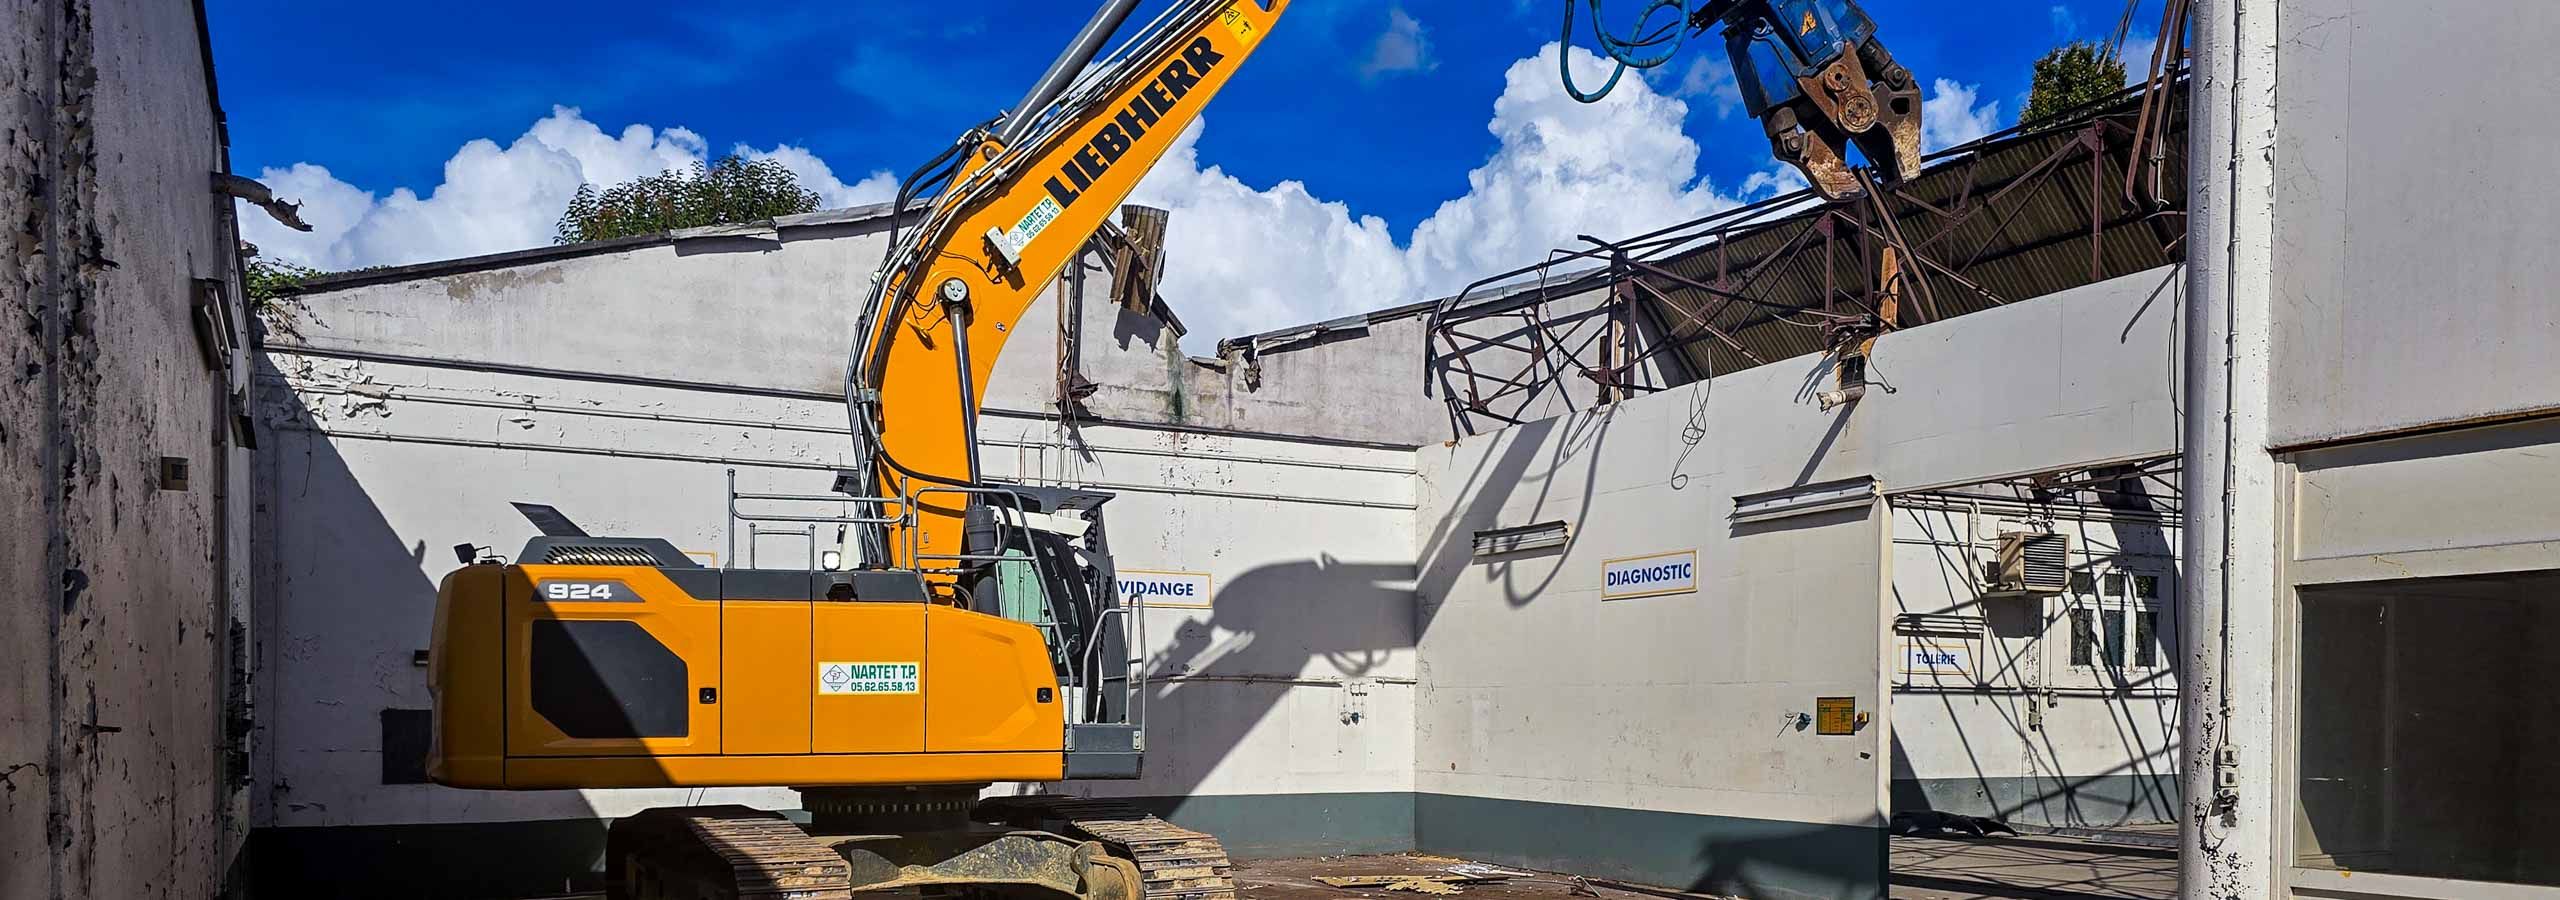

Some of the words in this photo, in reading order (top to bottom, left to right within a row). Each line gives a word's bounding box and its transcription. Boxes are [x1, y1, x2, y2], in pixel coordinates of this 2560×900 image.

[1043, 36, 1225, 209] LIEBHERR
[1018, 205, 1044, 233] NARTET
[1608, 563, 1691, 586] DIAGNOSTIC
[549, 583, 612, 599] 924
[1118, 581, 1193, 596] VIDANGE
[1916, 653, 1956, 665] TOLERIE
[851, 665, 897, 679] NARTET
[901, 665, 917, 679] T.P.
[851, 682, 915, 692] 05.62.65.58.13
